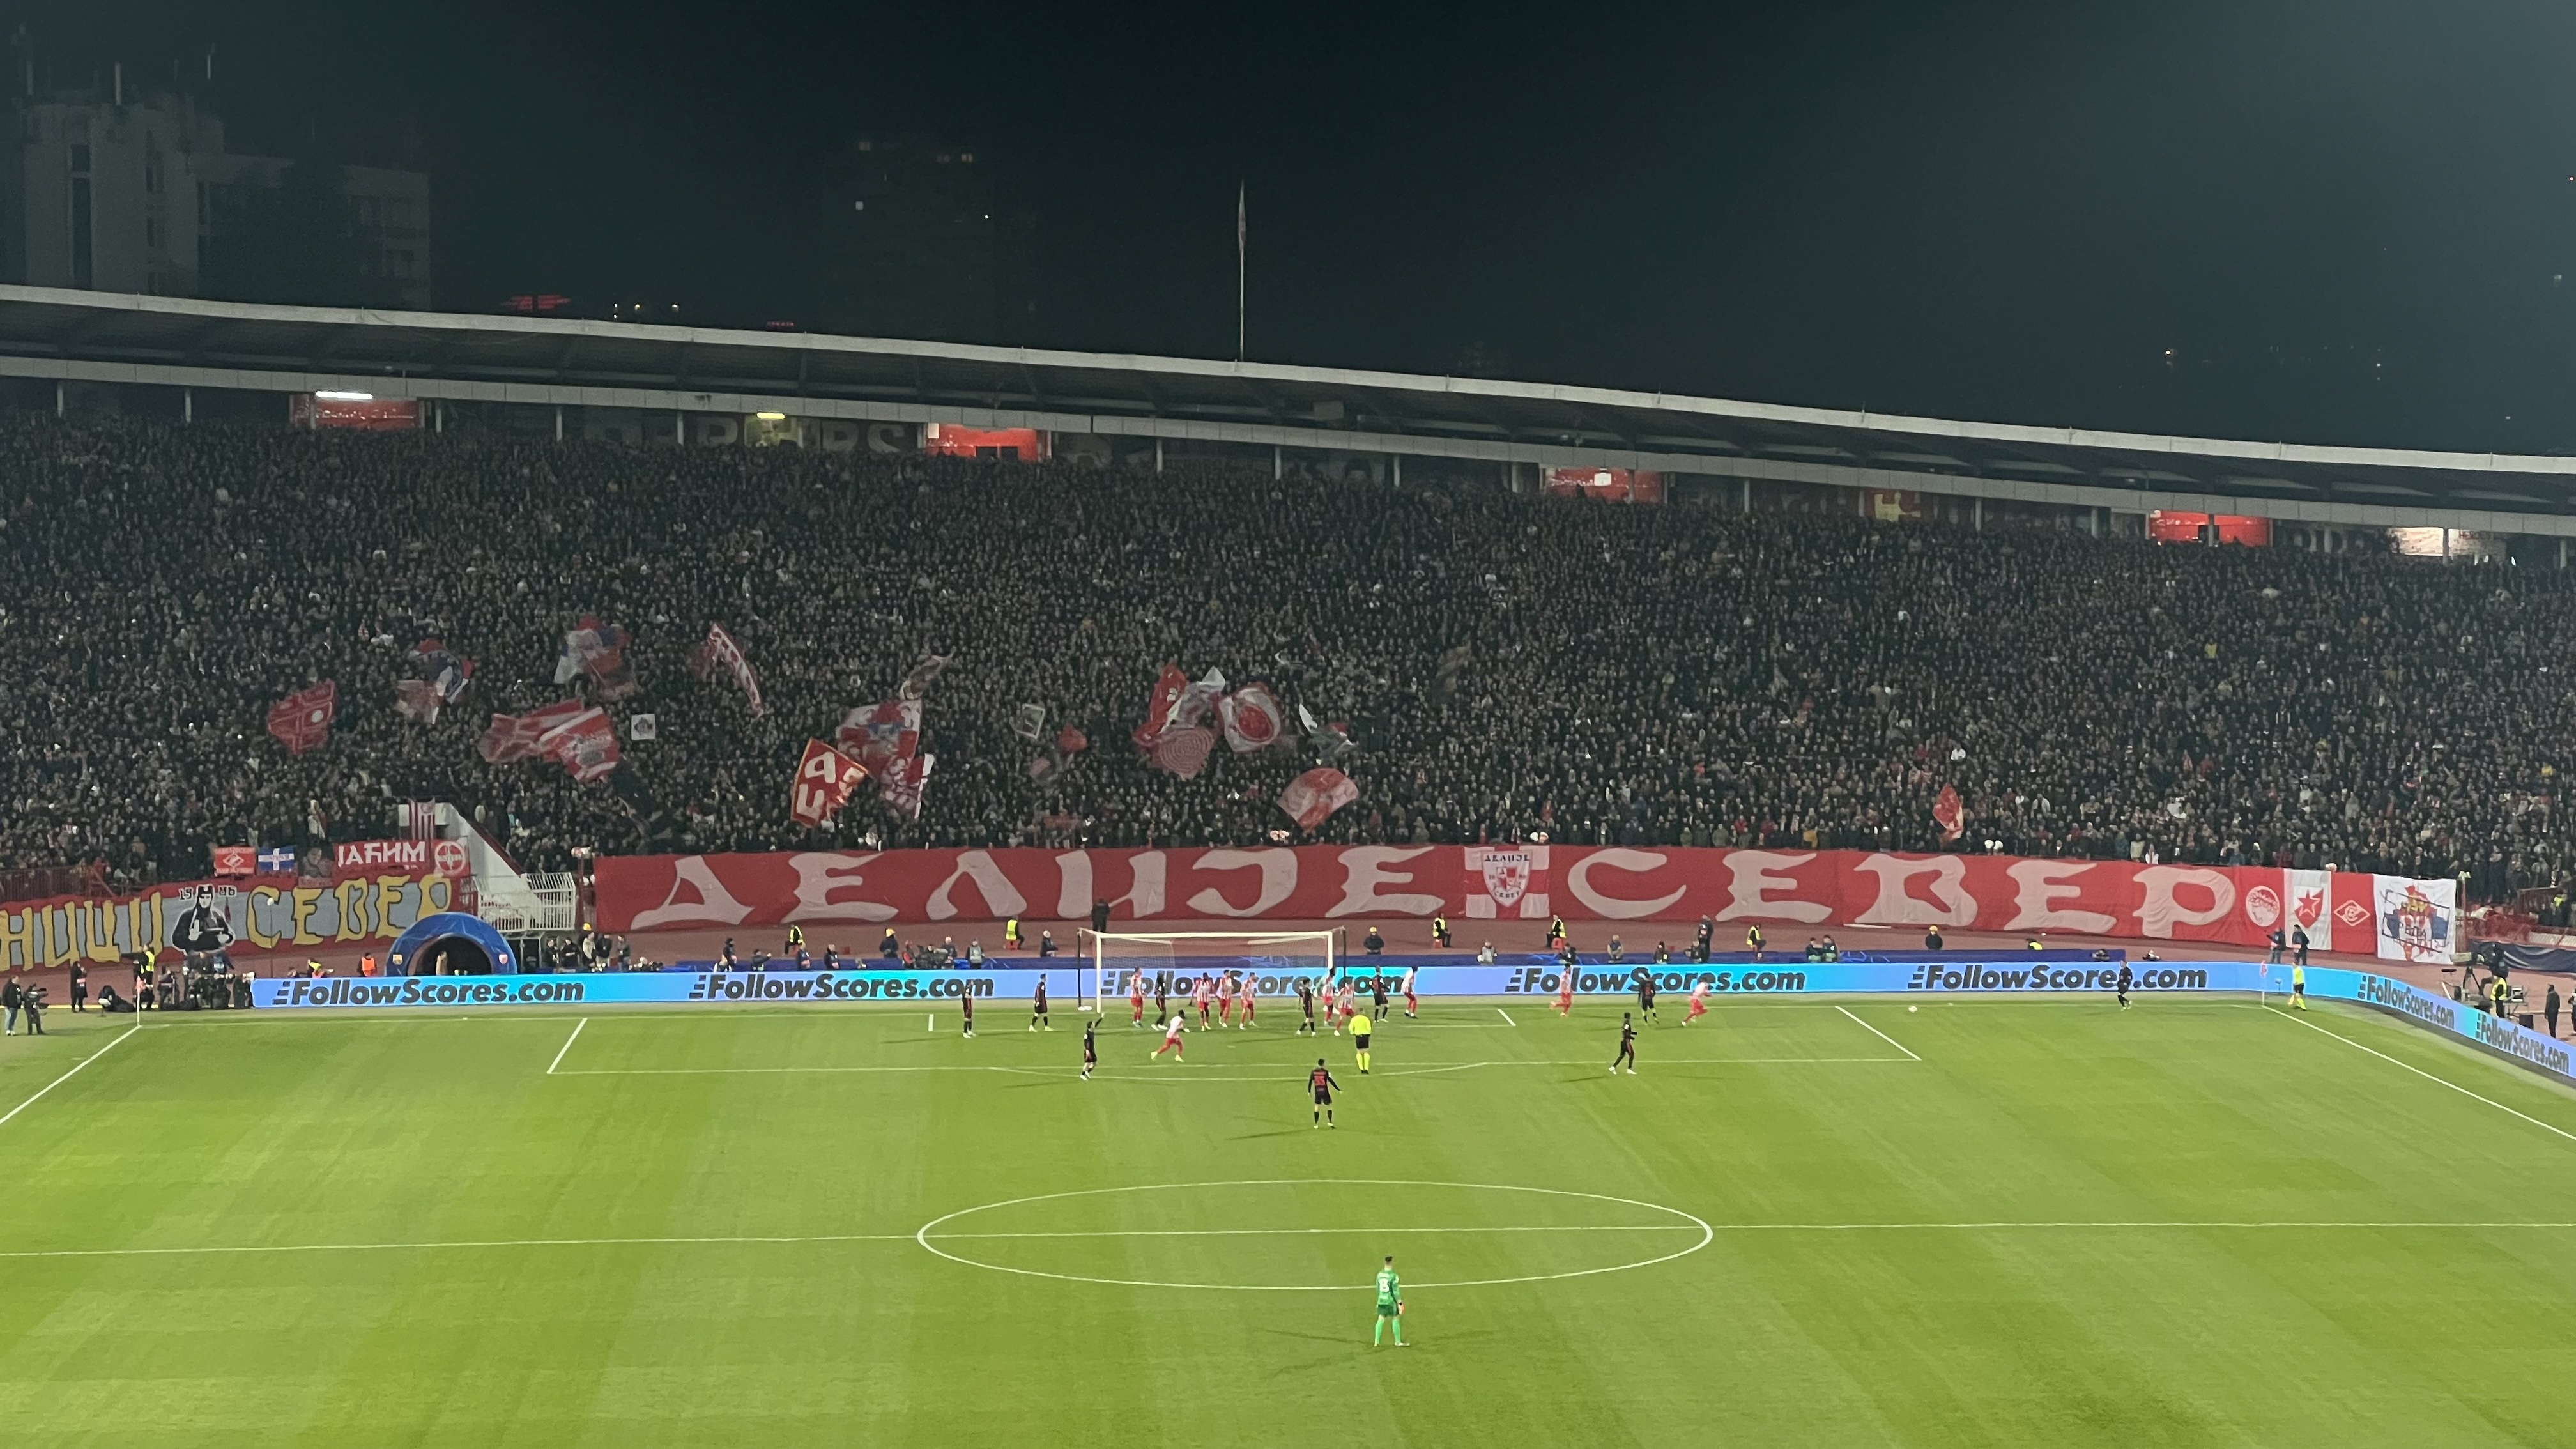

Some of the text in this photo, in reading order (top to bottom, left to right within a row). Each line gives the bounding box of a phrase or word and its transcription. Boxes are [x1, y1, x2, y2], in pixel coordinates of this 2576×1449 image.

[1568, 848, 2235, 939] СЕВЕР
[707, 974, 994, 999] FollowScores.com
[1523, 967, 1805, 992] FolowScores.com
[1926, 965, 2207, 990] FollowScore.com
[291, 979, 585, 1005] FollowScores.com
[2366, 976, 2455, 1030] FollowScores.com
[2480, 1014, 2570, 1073] FollowScores.com
